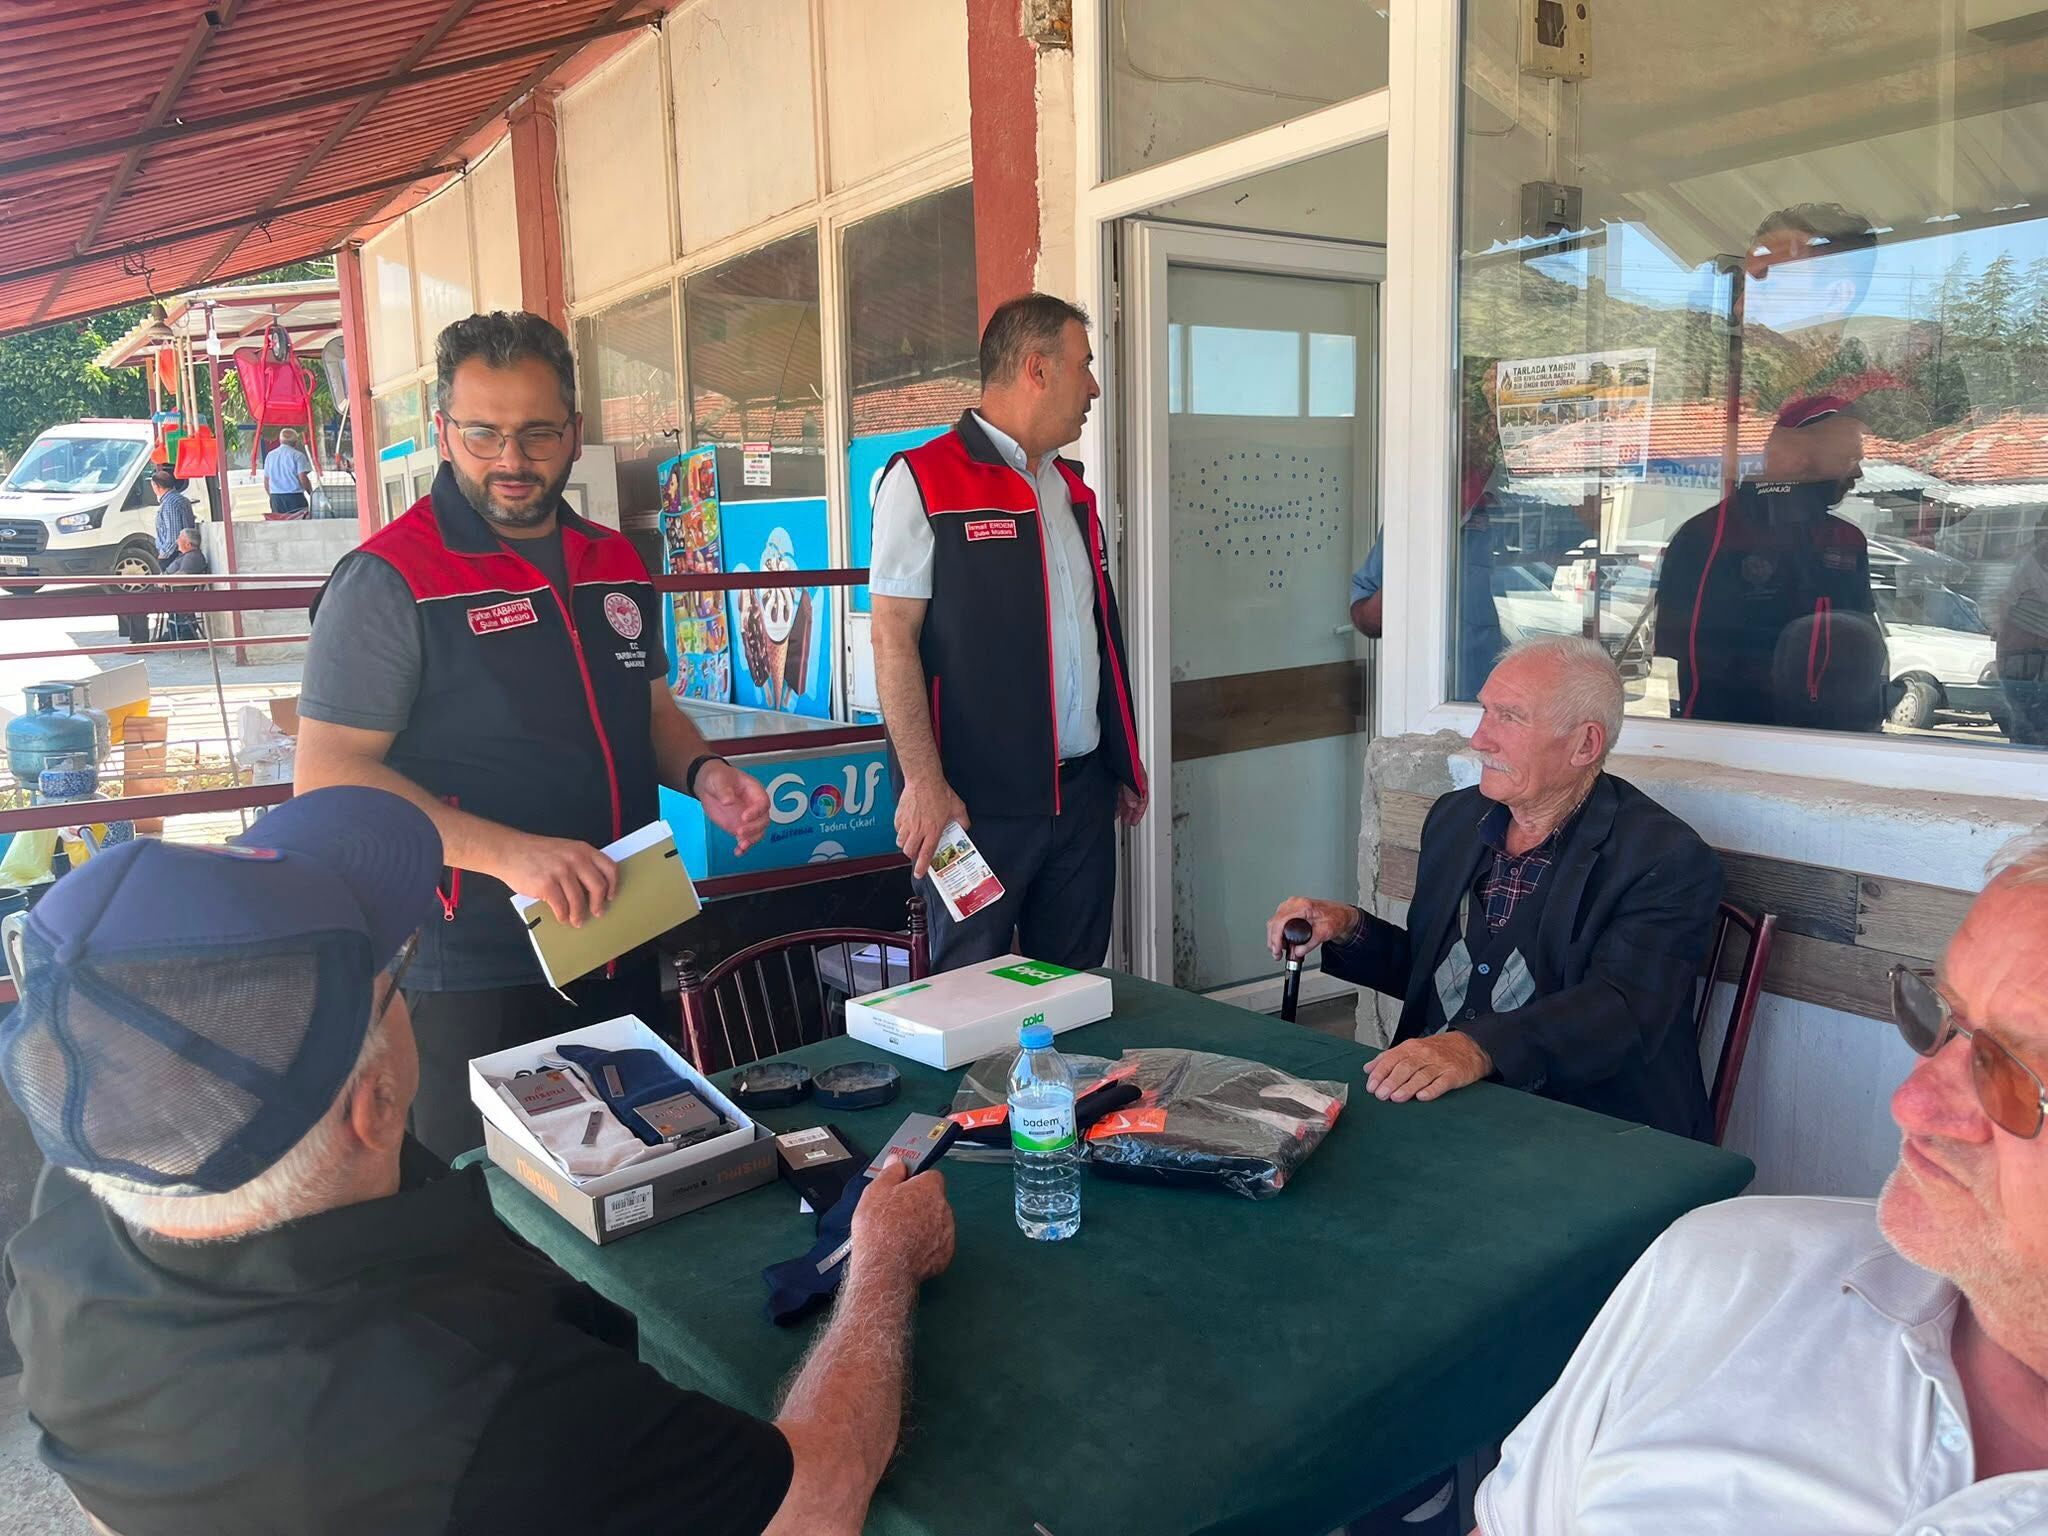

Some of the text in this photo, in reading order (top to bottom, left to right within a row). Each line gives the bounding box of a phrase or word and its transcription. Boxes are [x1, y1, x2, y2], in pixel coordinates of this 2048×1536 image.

[1513, 362, 1576, 375] TARLADA YANGIN
[491, 602, 531, 617] KABARTAN
[499, 612, 530, 625] Müdürü
[819, 822, 848, 834] Tadını
[849, 817, 876, 833] Çıkar!
[1023, 1117, 1059, 1128] badem
